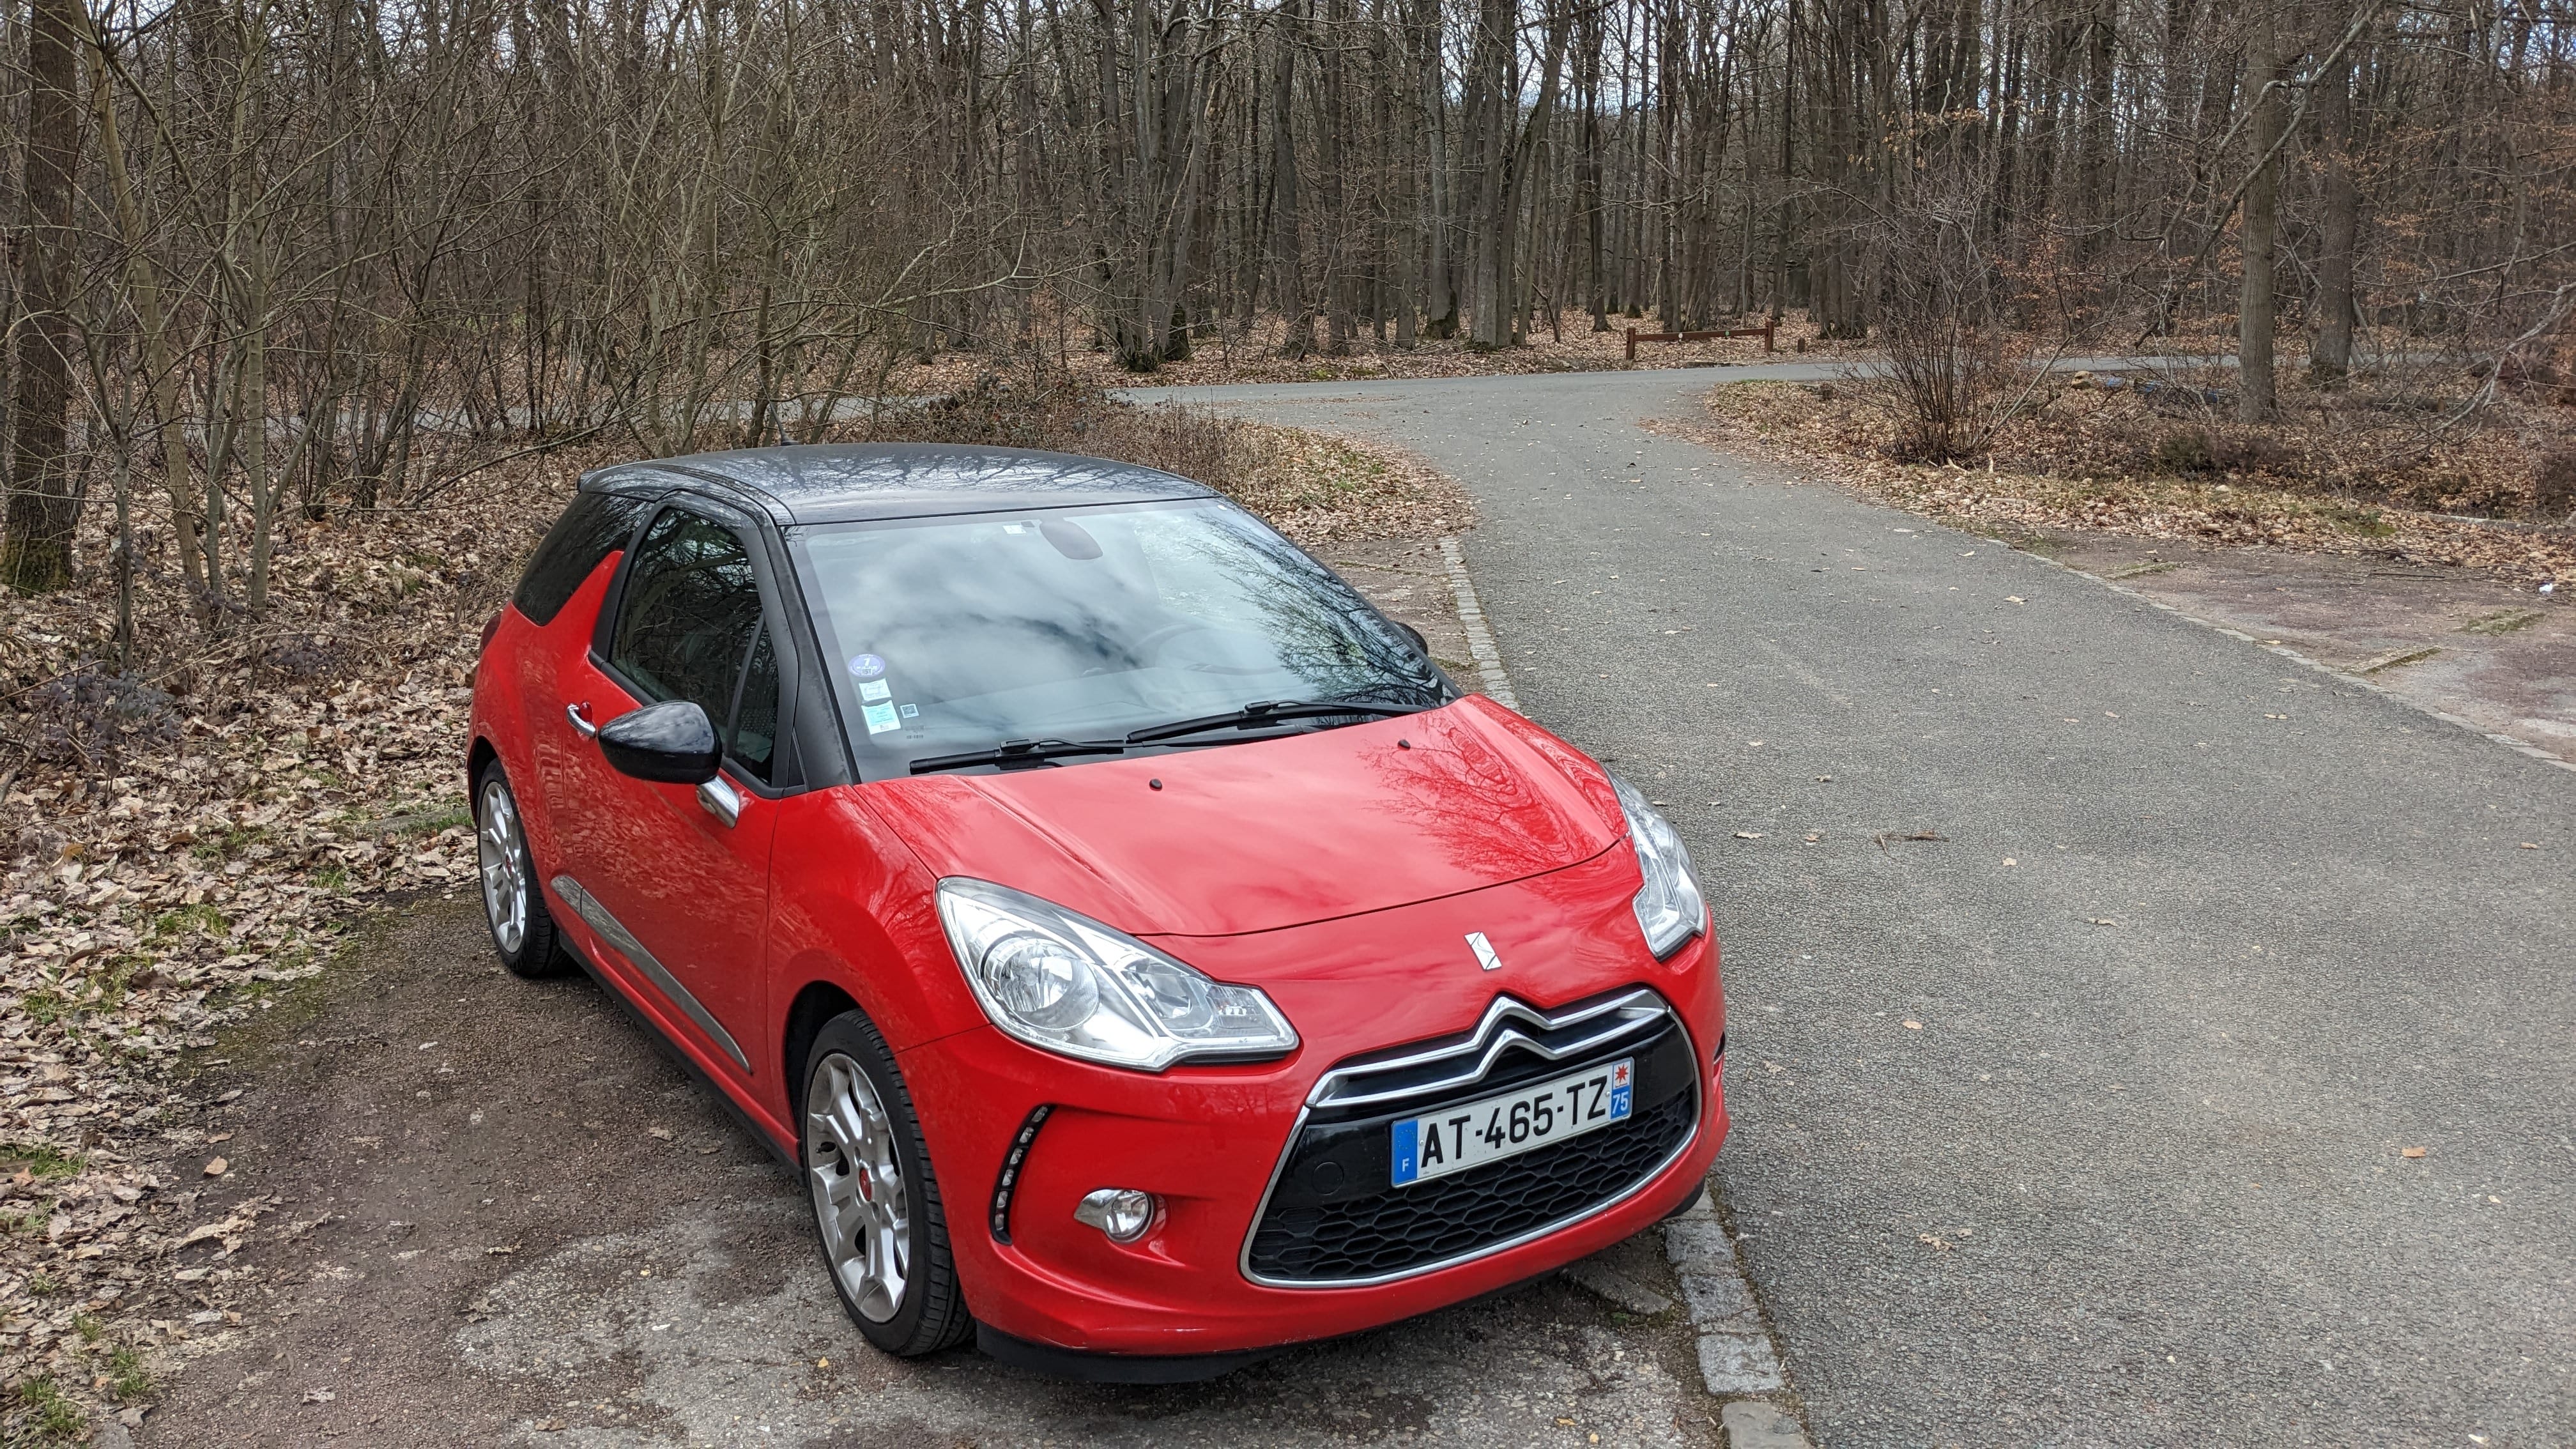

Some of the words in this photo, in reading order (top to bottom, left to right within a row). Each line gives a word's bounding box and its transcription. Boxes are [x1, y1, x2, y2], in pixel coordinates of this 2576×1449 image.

[1612, 1091, 1629, 1114] 75
[1420, 1075, 1608, 1169] AT-465-TZ
[1402, 1157, 1410, 1172] F
